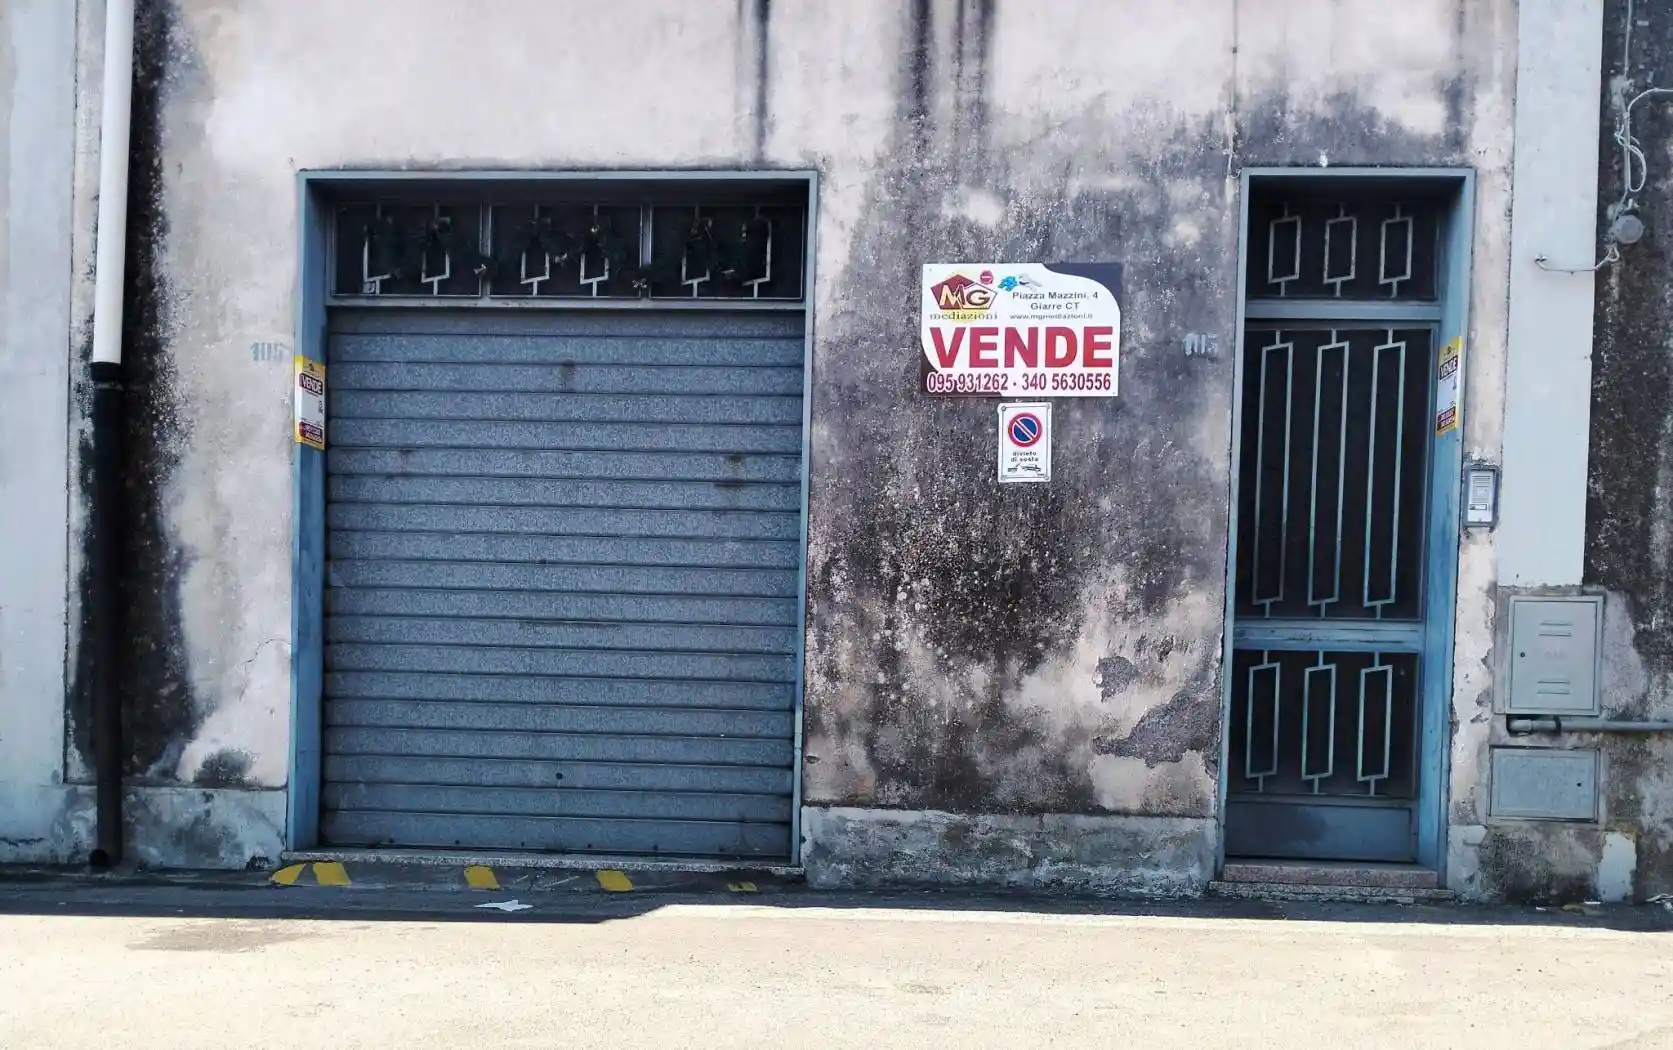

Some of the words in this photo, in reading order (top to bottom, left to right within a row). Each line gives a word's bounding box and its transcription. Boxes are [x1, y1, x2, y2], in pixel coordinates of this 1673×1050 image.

[939, 284, 991, 308] MG
[1012, 291, 1045, 300] Piazza
[1092, 291, 1099, 299] 4
[930, 311, 998, 320] mediazioni
[1030, 302, 1062, 310] Giarre
[1065, 302, 1080, 310] CT
[929, 326, 1113, 369] VENDE
[302, 375, 323, 395] VENDE
[1022, 373, 1047, 391] 340
[1052, 372, 1111, 391] 5630556
